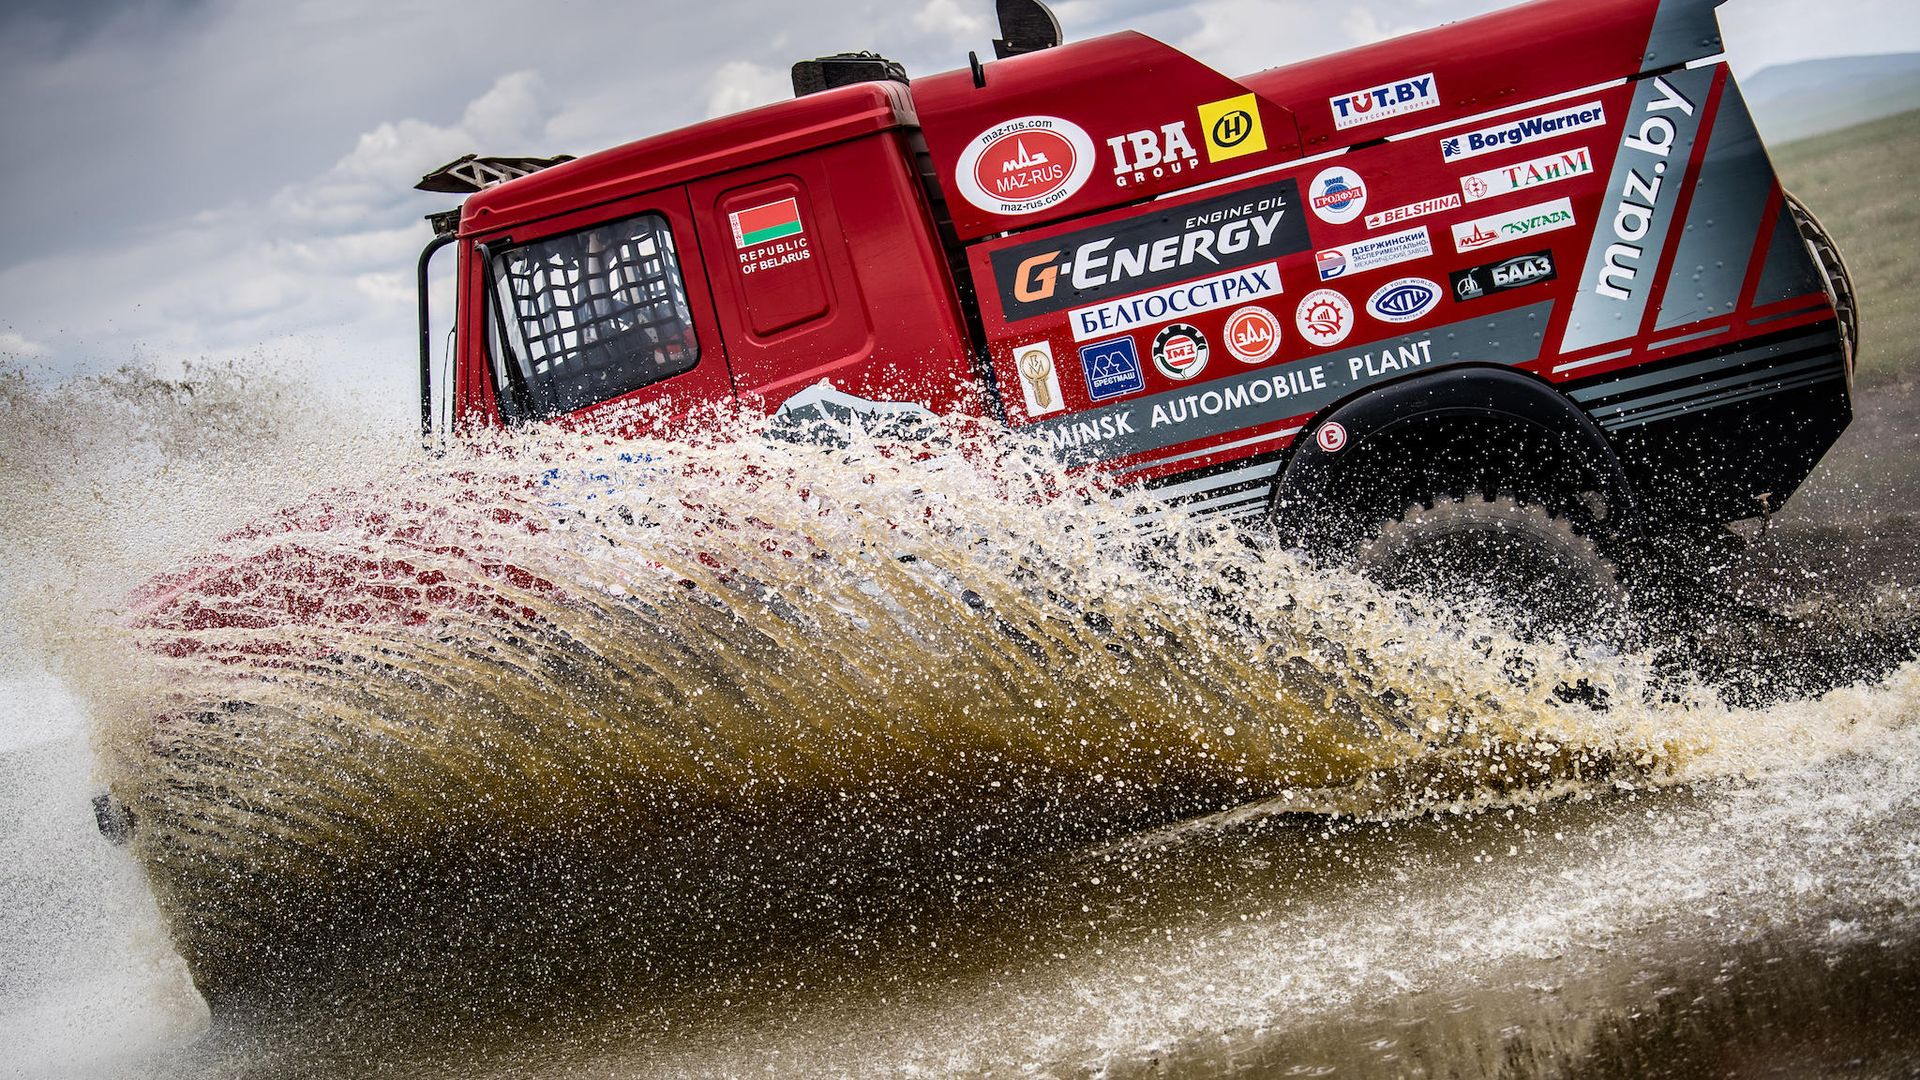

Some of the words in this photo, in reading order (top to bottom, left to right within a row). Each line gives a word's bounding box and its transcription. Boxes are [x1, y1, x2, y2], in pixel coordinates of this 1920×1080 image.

[1333, 77, 1431, 117] TUT.BY
[981, 119, 1053, 145] maz-rus.com
[1468, 106, 1602, 151] BorgWarner
[1106, 120, 1197, 176] IBA
[996, 164, 1064, 193] MAZ-RUS
[1115, 158, 1199, 187] GROUP
[1000, 187, 1068, 212] maz-rus.com
[1315, 188, 1361, 207] ГРОДФУД
[1595, 76, 1696, 301] maz.by
[1184, 203, 1256, 229] ENGINE
[1257, 196, 1287, 211] OIL
[1384, 195, 1460, 223] BELSHINA
[739, 238, 808, 263] REPUBLIC
[1351, 231, 1425, 256] ДЗЕРЖИНСКИЙ
[1352, 239, 1429, 262] ЭКСПЕРИМЕНТАЛЬНО-
[1407, 246, 1429, 256] ЗАВОД
[742, 262, 758, 275] OF
[760, 249, 810, 271] BELARUS
[1491, 257, 1551, 287] БААЗ
[1390, 279, 1407, 288] YOUR
[1080, 269, 1272, 334] БЕЛГОССТРАХ
[1093, 372, 1136, 388] БРЕСТМАШ
[1048, 411, 1135, 452] MINSK
[1150, 365, 1327, 429] AUTOMOBILE
[1347, 339, 1432, 381] PLANT
[1325, 429, 1338, 445] E
